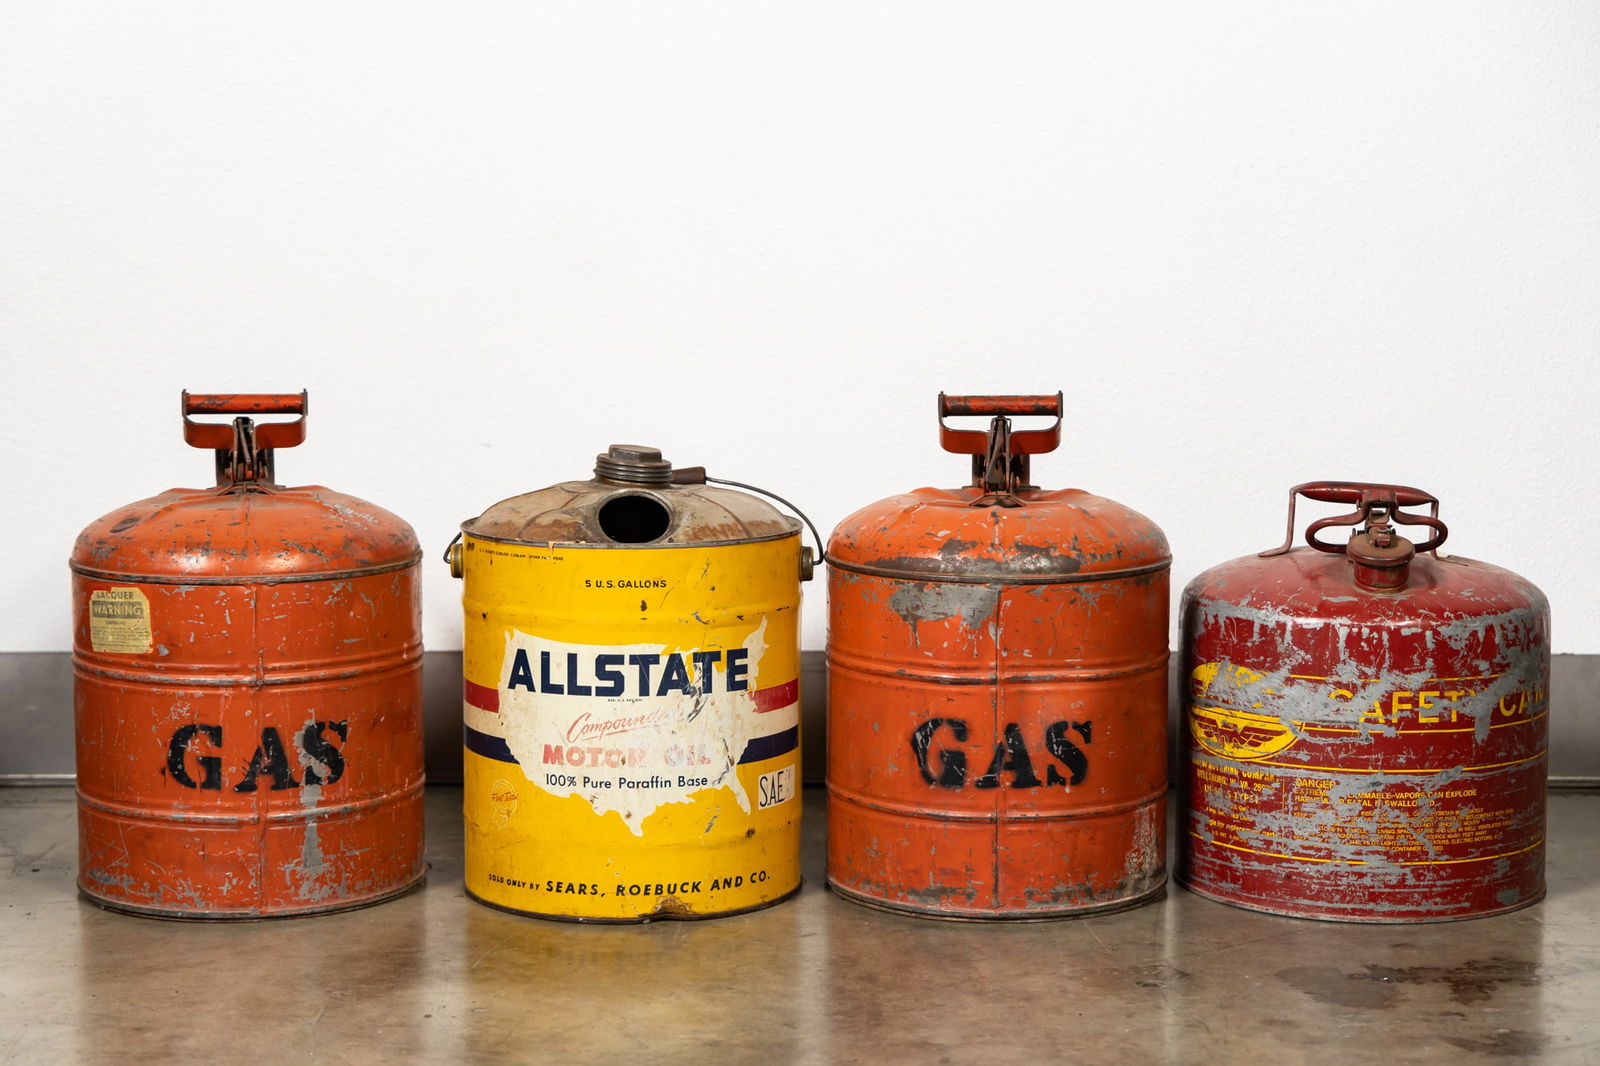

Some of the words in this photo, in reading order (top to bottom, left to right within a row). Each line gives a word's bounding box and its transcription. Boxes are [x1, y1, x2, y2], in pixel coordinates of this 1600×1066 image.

[584, 579, 592, 588] 5
[617, 579, 667, 588] GALLONS
[93, 603, 142, 616] WARNING
[508, 648, 749, 697] ALLSTATE
[166, 719, 348, 792] GAS
[911, 717, 1088, 789] GAS
[546, 773, 577, 787] 100%
[583, 776, 612, 789] Pure
[619, 776, 672, 789] Paraffin
[678, 776, 708, 788] Base
[1445, 788, 1478, 798] EXPLODE
[1384, 799, 1435, 807] SWALLOD
[488, 873, 505, 884] SOLD
[506, 878, 527, 888] ONLY
[529, 882, 540, 891] BY
[546, 880, 606, 898] SEARS,
[616, 880, 702, 897] ROEBUCK
[710, 875, 743, 892] AND
[750, 869, 771, 884] CO.
